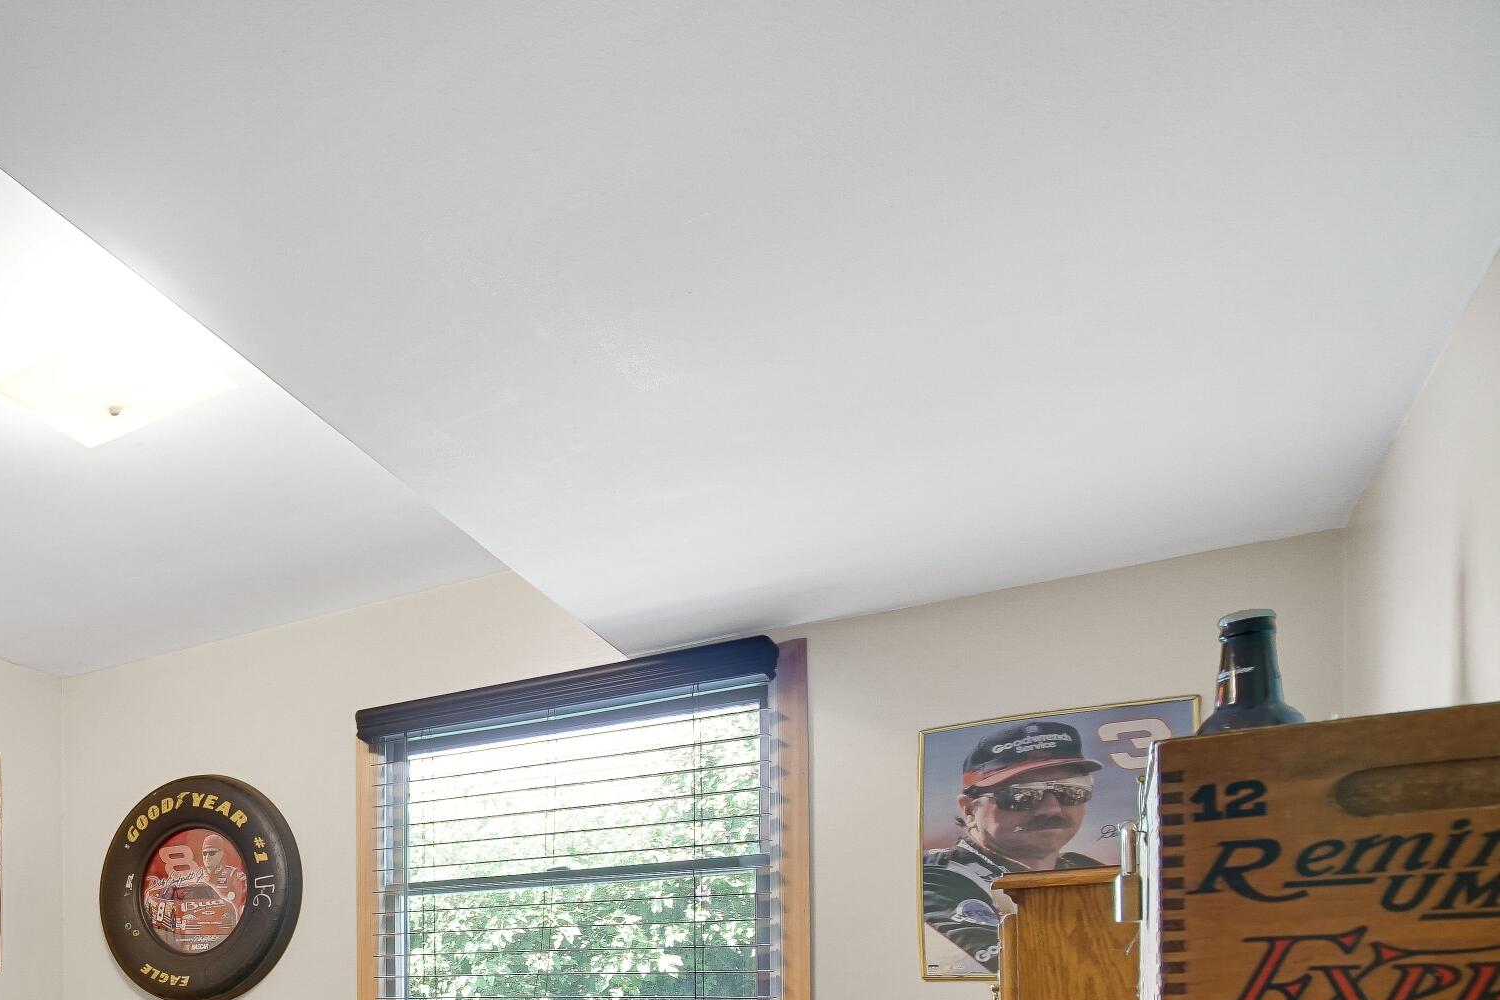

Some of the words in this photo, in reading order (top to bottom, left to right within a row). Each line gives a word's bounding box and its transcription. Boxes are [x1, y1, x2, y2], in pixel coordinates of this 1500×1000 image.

[992, 733, 1072, 754] Goodwrench
[1016, 741, 1057, 754] Service
[1098, 718, 1172, 770] 3
[1189, 779, 1268, 822] 12
[127, 791, 248, 843] GOODYEAR
[158, 844, 200, 874] 8
[140, 963, 190, 987] EAGLE
